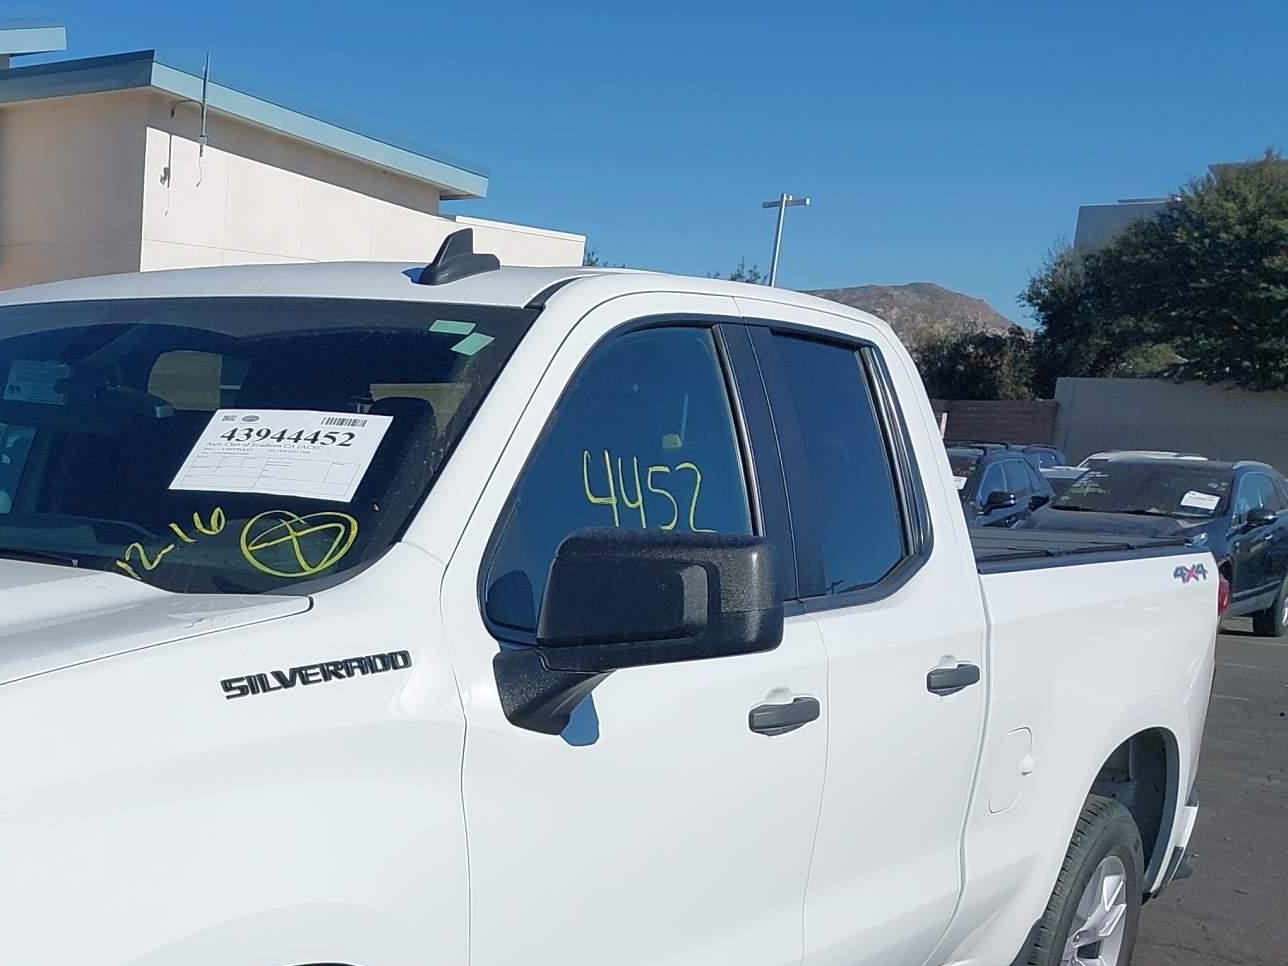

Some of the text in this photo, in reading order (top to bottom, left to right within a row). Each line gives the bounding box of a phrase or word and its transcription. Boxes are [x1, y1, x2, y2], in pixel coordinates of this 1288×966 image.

[220, 427, 356, 448] 43944452
[583, 450, 718, 533] 4452
[220, 650, 413, 700] SILVERADO
